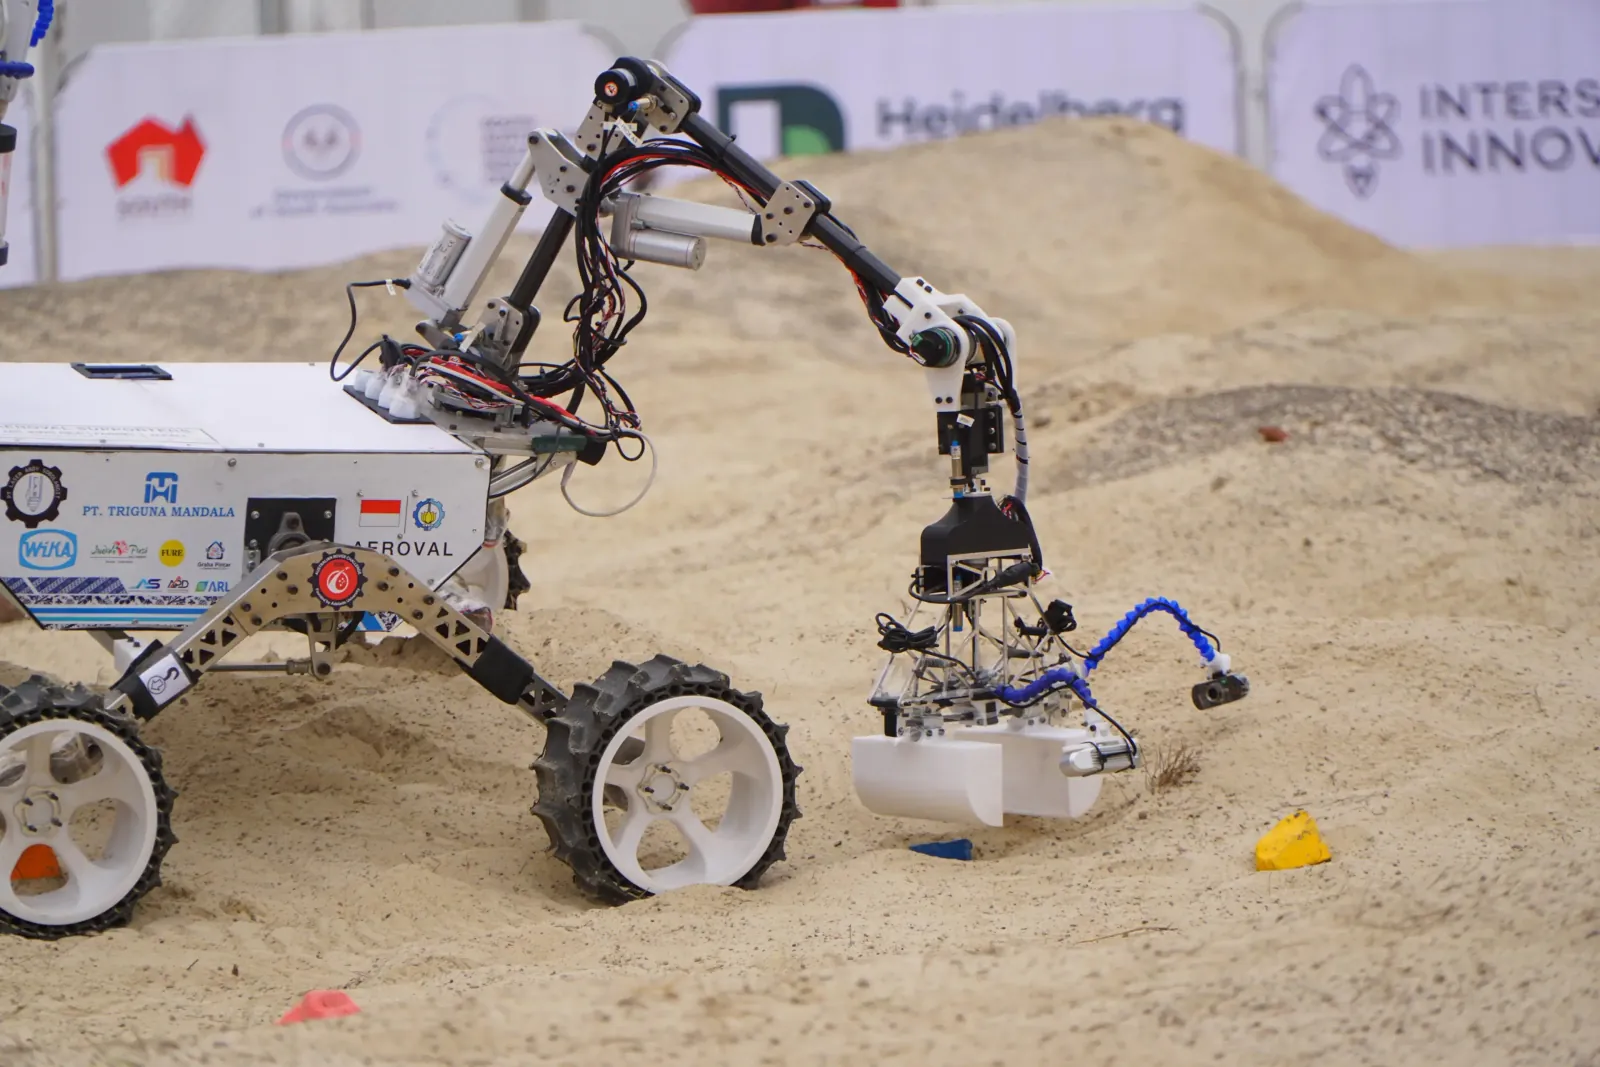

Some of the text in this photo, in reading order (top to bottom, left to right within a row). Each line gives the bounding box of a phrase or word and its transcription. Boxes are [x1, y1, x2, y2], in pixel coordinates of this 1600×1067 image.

[82, 506, 235, 518] PT. TRIGUNA MANDALA
